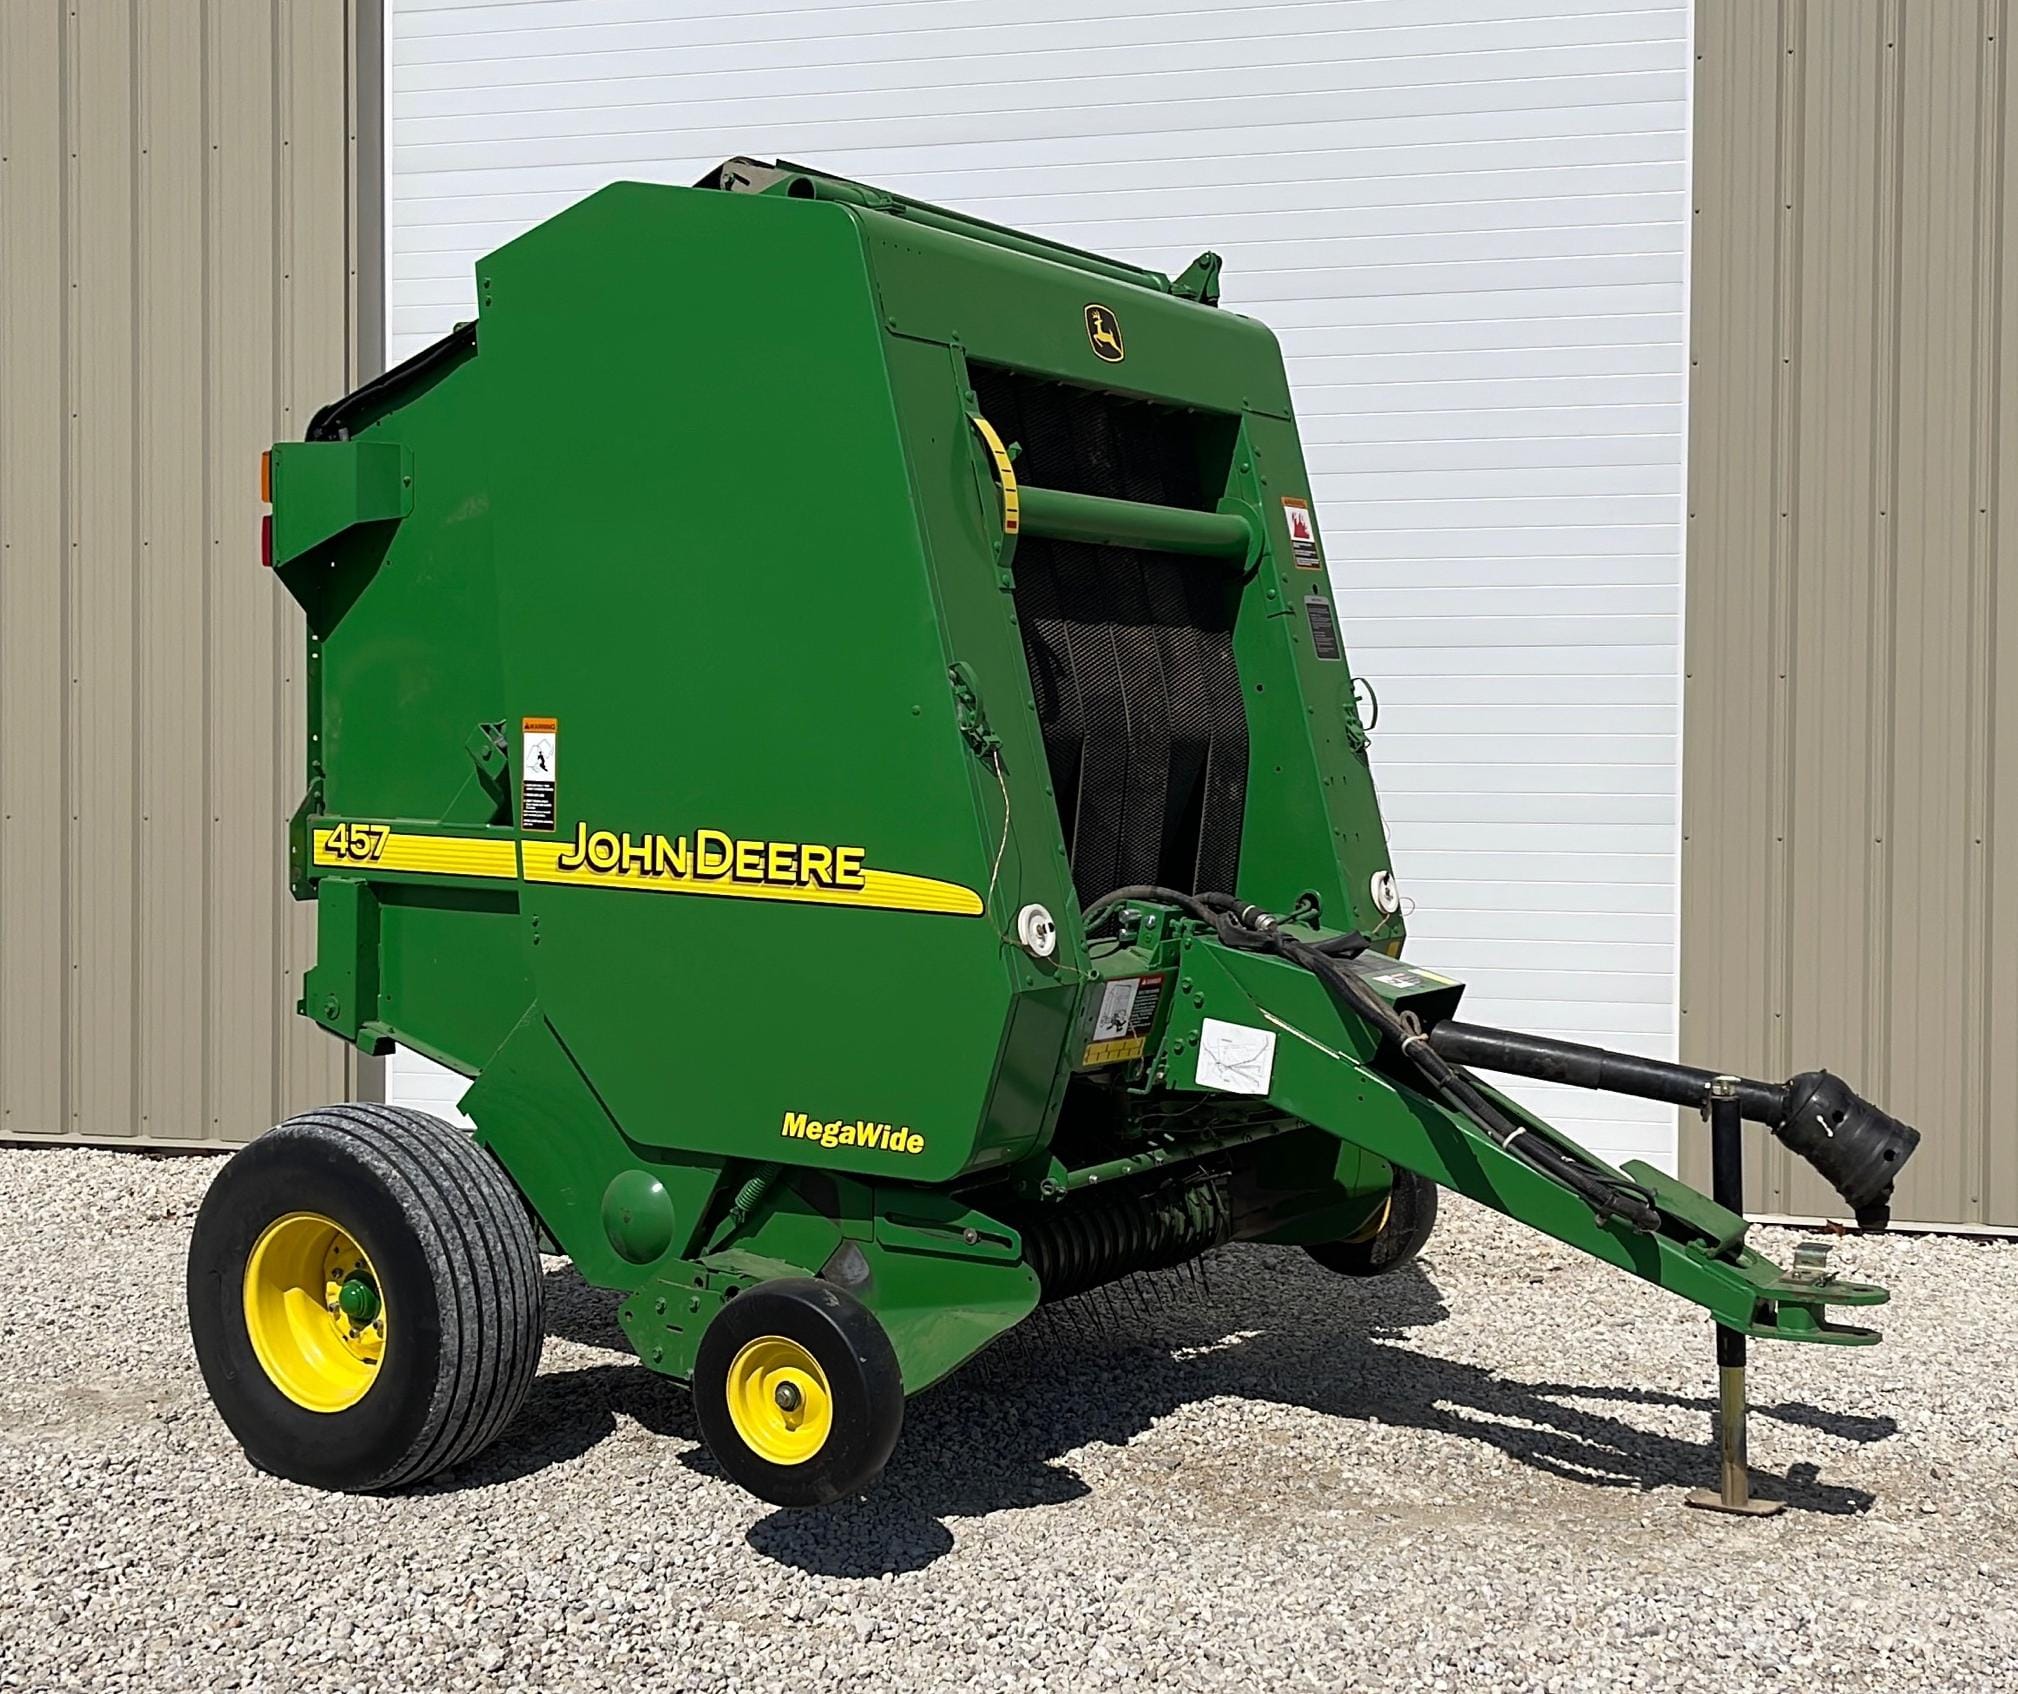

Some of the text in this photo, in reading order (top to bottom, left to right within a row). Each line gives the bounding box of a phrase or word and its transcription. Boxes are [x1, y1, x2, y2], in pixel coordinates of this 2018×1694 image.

[327, 822, 391, 859] 457
[559, 821, 866, 891] JOHN DEERE
[781, 1111, 925, 1154] MegaWide
